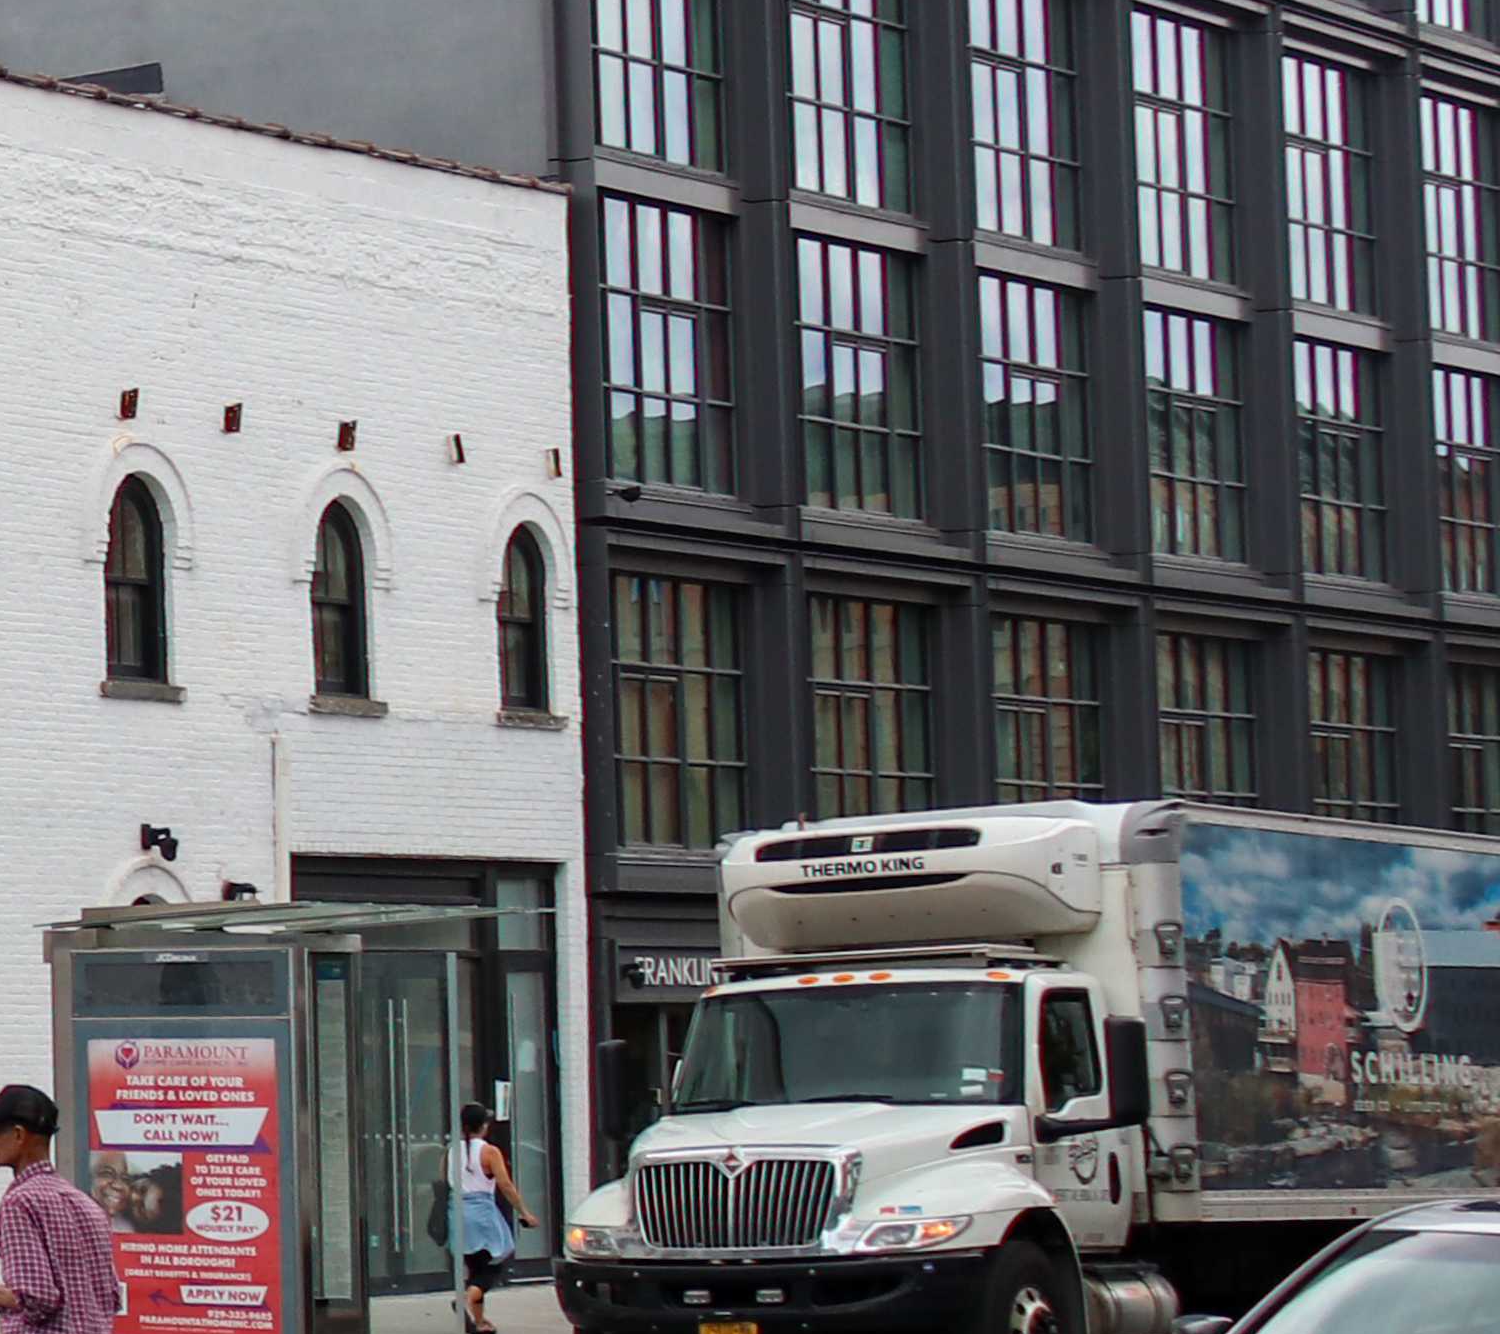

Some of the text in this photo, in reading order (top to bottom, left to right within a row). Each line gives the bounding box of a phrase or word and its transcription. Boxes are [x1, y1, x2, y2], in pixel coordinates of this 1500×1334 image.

[801, 856, 926, 877] THERMO KING
[143, 1045, 249, 1060] PARAMOUNT
[1351, 1051, 1473, 1086] SCHILLING
[126, 1075, 244, 1088] TAKE CARE OF YOUR
[116, 1089, 255, 1102] FRIENDS & LOVED ONES
[134, 1113, 230, 1127] DON'T WAIT...
[143, 1130, 220, 1142] CALL NOW!
[206, 1154, 249, 1164] GET PAID
[195, 1165, 262, 1175] TO TAKE CARE
[190, 1177, 267, 1187] OF YOUR LOVED
[195, 1188, 262, 1198] ONES TODAY!
[210, 1204, 243, 1223] $21
[196, 1224, 235, 1234] HOURLY
[120, 1242, 257, 1256] HIRING HOME ATTENDANTS
[140, 1255, 236, 1268] IN ALL BOROUGHS!
[155, 1269, 190, 1279] BENEFITS
[191, 1270, 199, 1279] &
[187, 1289, 262, 1302] APPLY NOW
